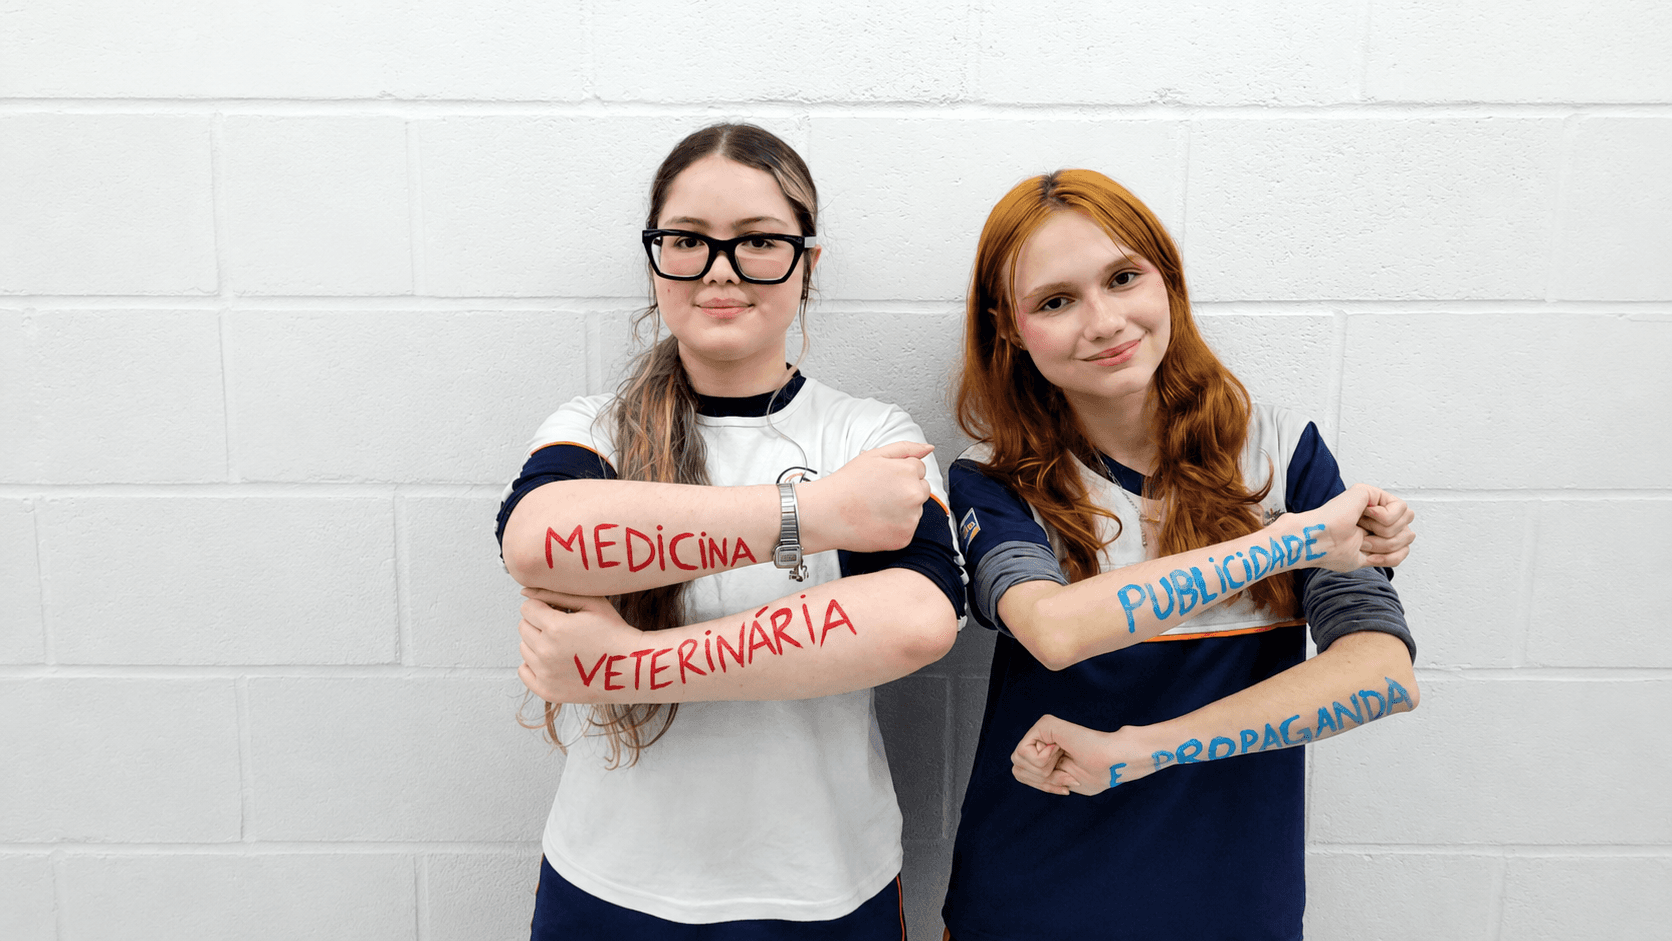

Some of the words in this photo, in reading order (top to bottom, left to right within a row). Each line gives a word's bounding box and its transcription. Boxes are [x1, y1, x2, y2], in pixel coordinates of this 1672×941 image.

[545, 523, 758, 573] MEDICINA
[1117, 523, 1328, 634] PUBLICIDADE
[573, 594, 858, 691] VETERINÁRIA
[1109, 762, 1128, 789] E
[1151, 676, 1414, 771] PROPAGANDA
